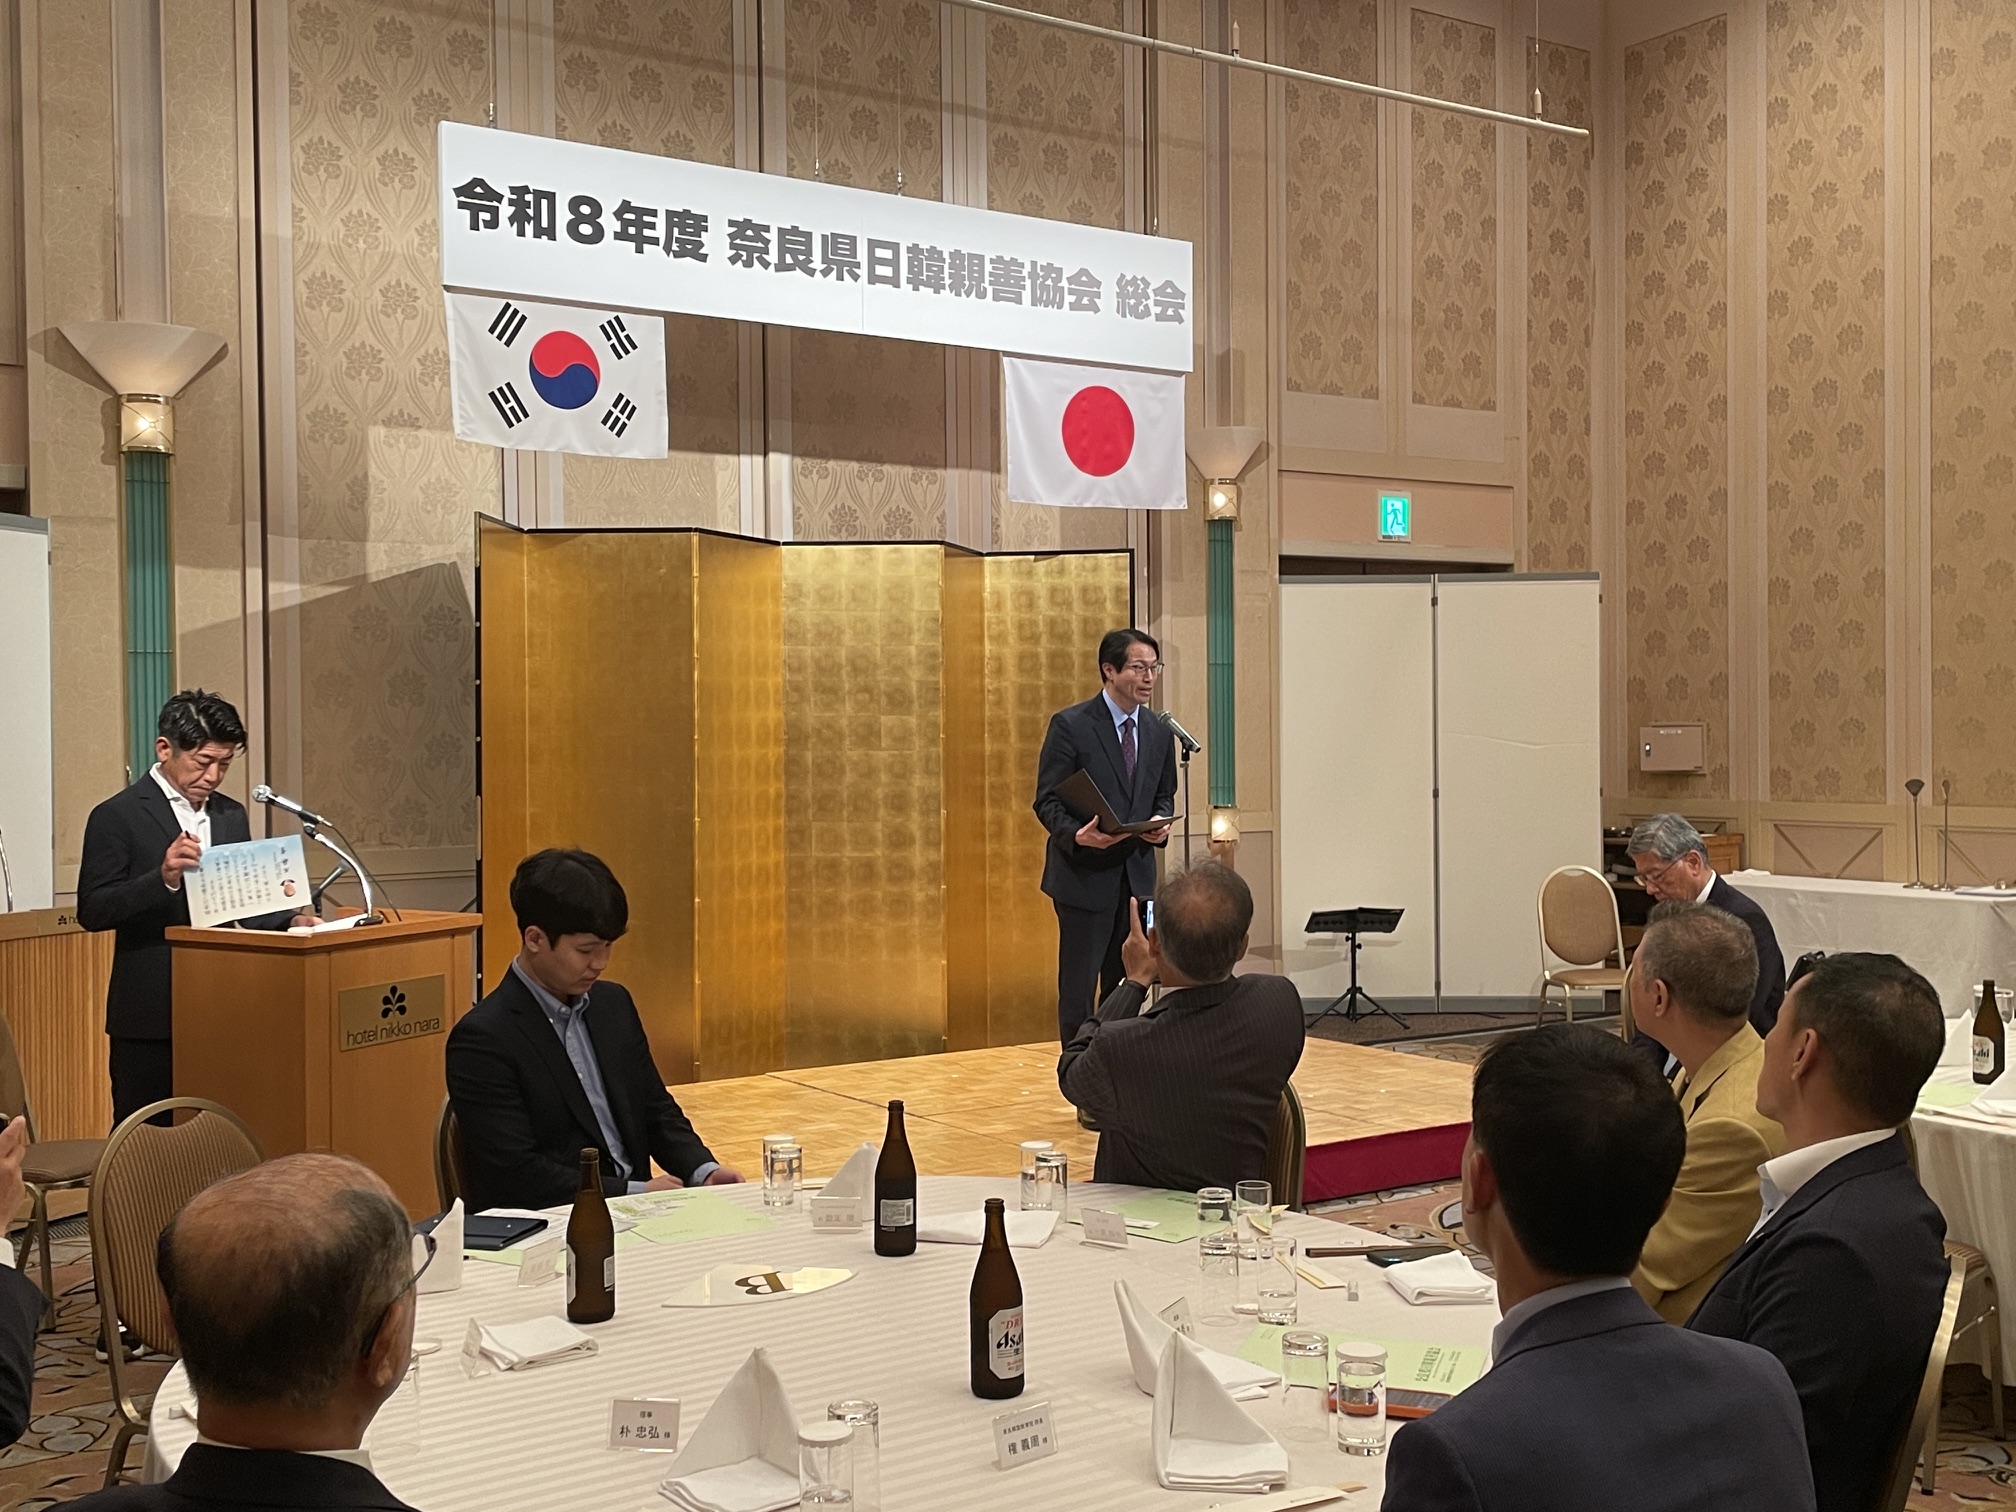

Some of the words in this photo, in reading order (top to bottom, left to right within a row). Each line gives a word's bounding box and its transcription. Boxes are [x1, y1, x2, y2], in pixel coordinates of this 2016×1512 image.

[453, 176, 709, 263] 令和8年度
[727, 218, 1102, 315] 奈良県日韓親善協会
[1115, 272, 1187, 325] 総会
[347, 1025, 378, 1046] hotel
[381, 1021, 411, 1040] nikko
[414, 1018, 440, 1034] nara
[1005, 1318, 1023, 1329] DR
